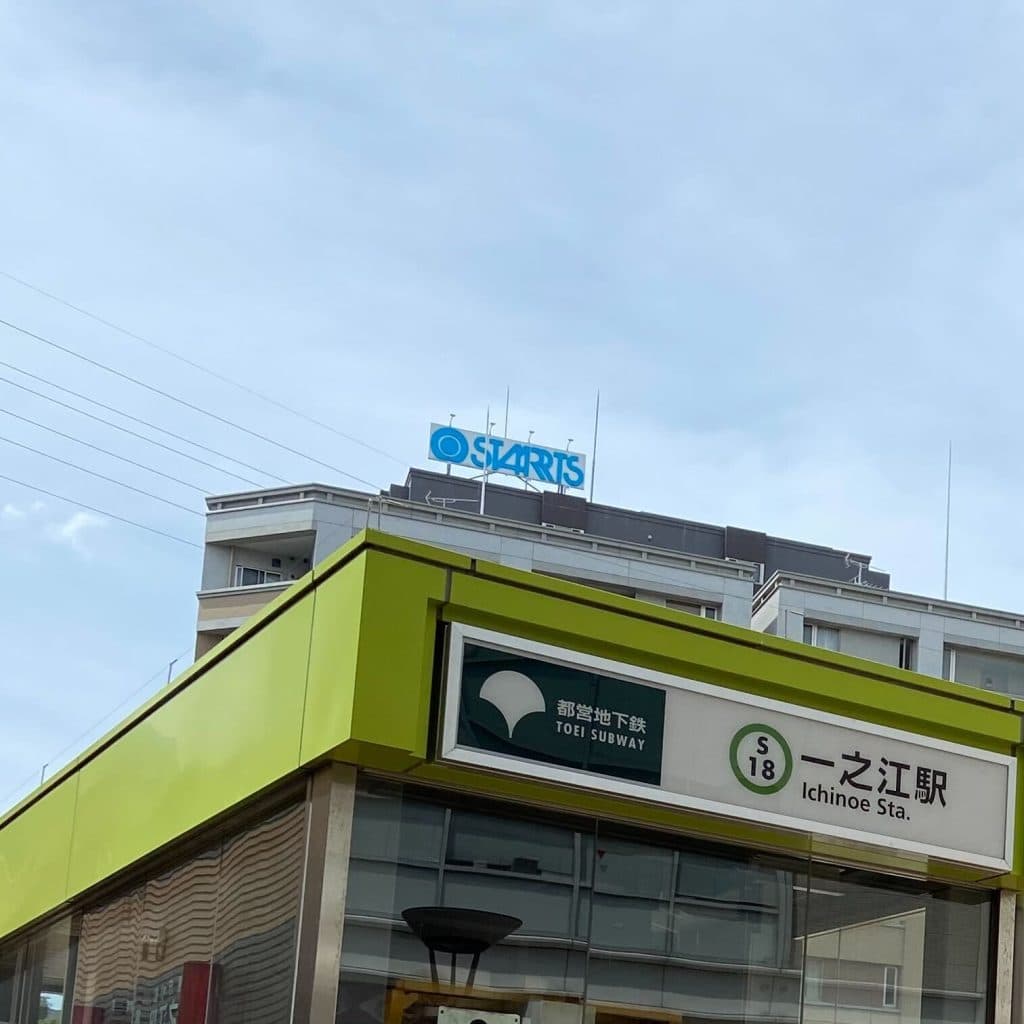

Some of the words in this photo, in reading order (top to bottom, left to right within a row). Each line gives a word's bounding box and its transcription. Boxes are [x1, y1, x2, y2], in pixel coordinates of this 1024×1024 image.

[470, 436, 584, 487] STARTS
[556, 699, 646, 735] 都営地下鉄
[556, 721, 585, 738] TOEI
[591, 729, 645, 751] SUBWAY
[756, 736, 769, 755] S
[749, 756, 775, 781] 18
[801, 751, 947, 807] 一之江駅
[802, 782, 870, 812] Ichinoe
[877, 799, 911, 821] Sta.
